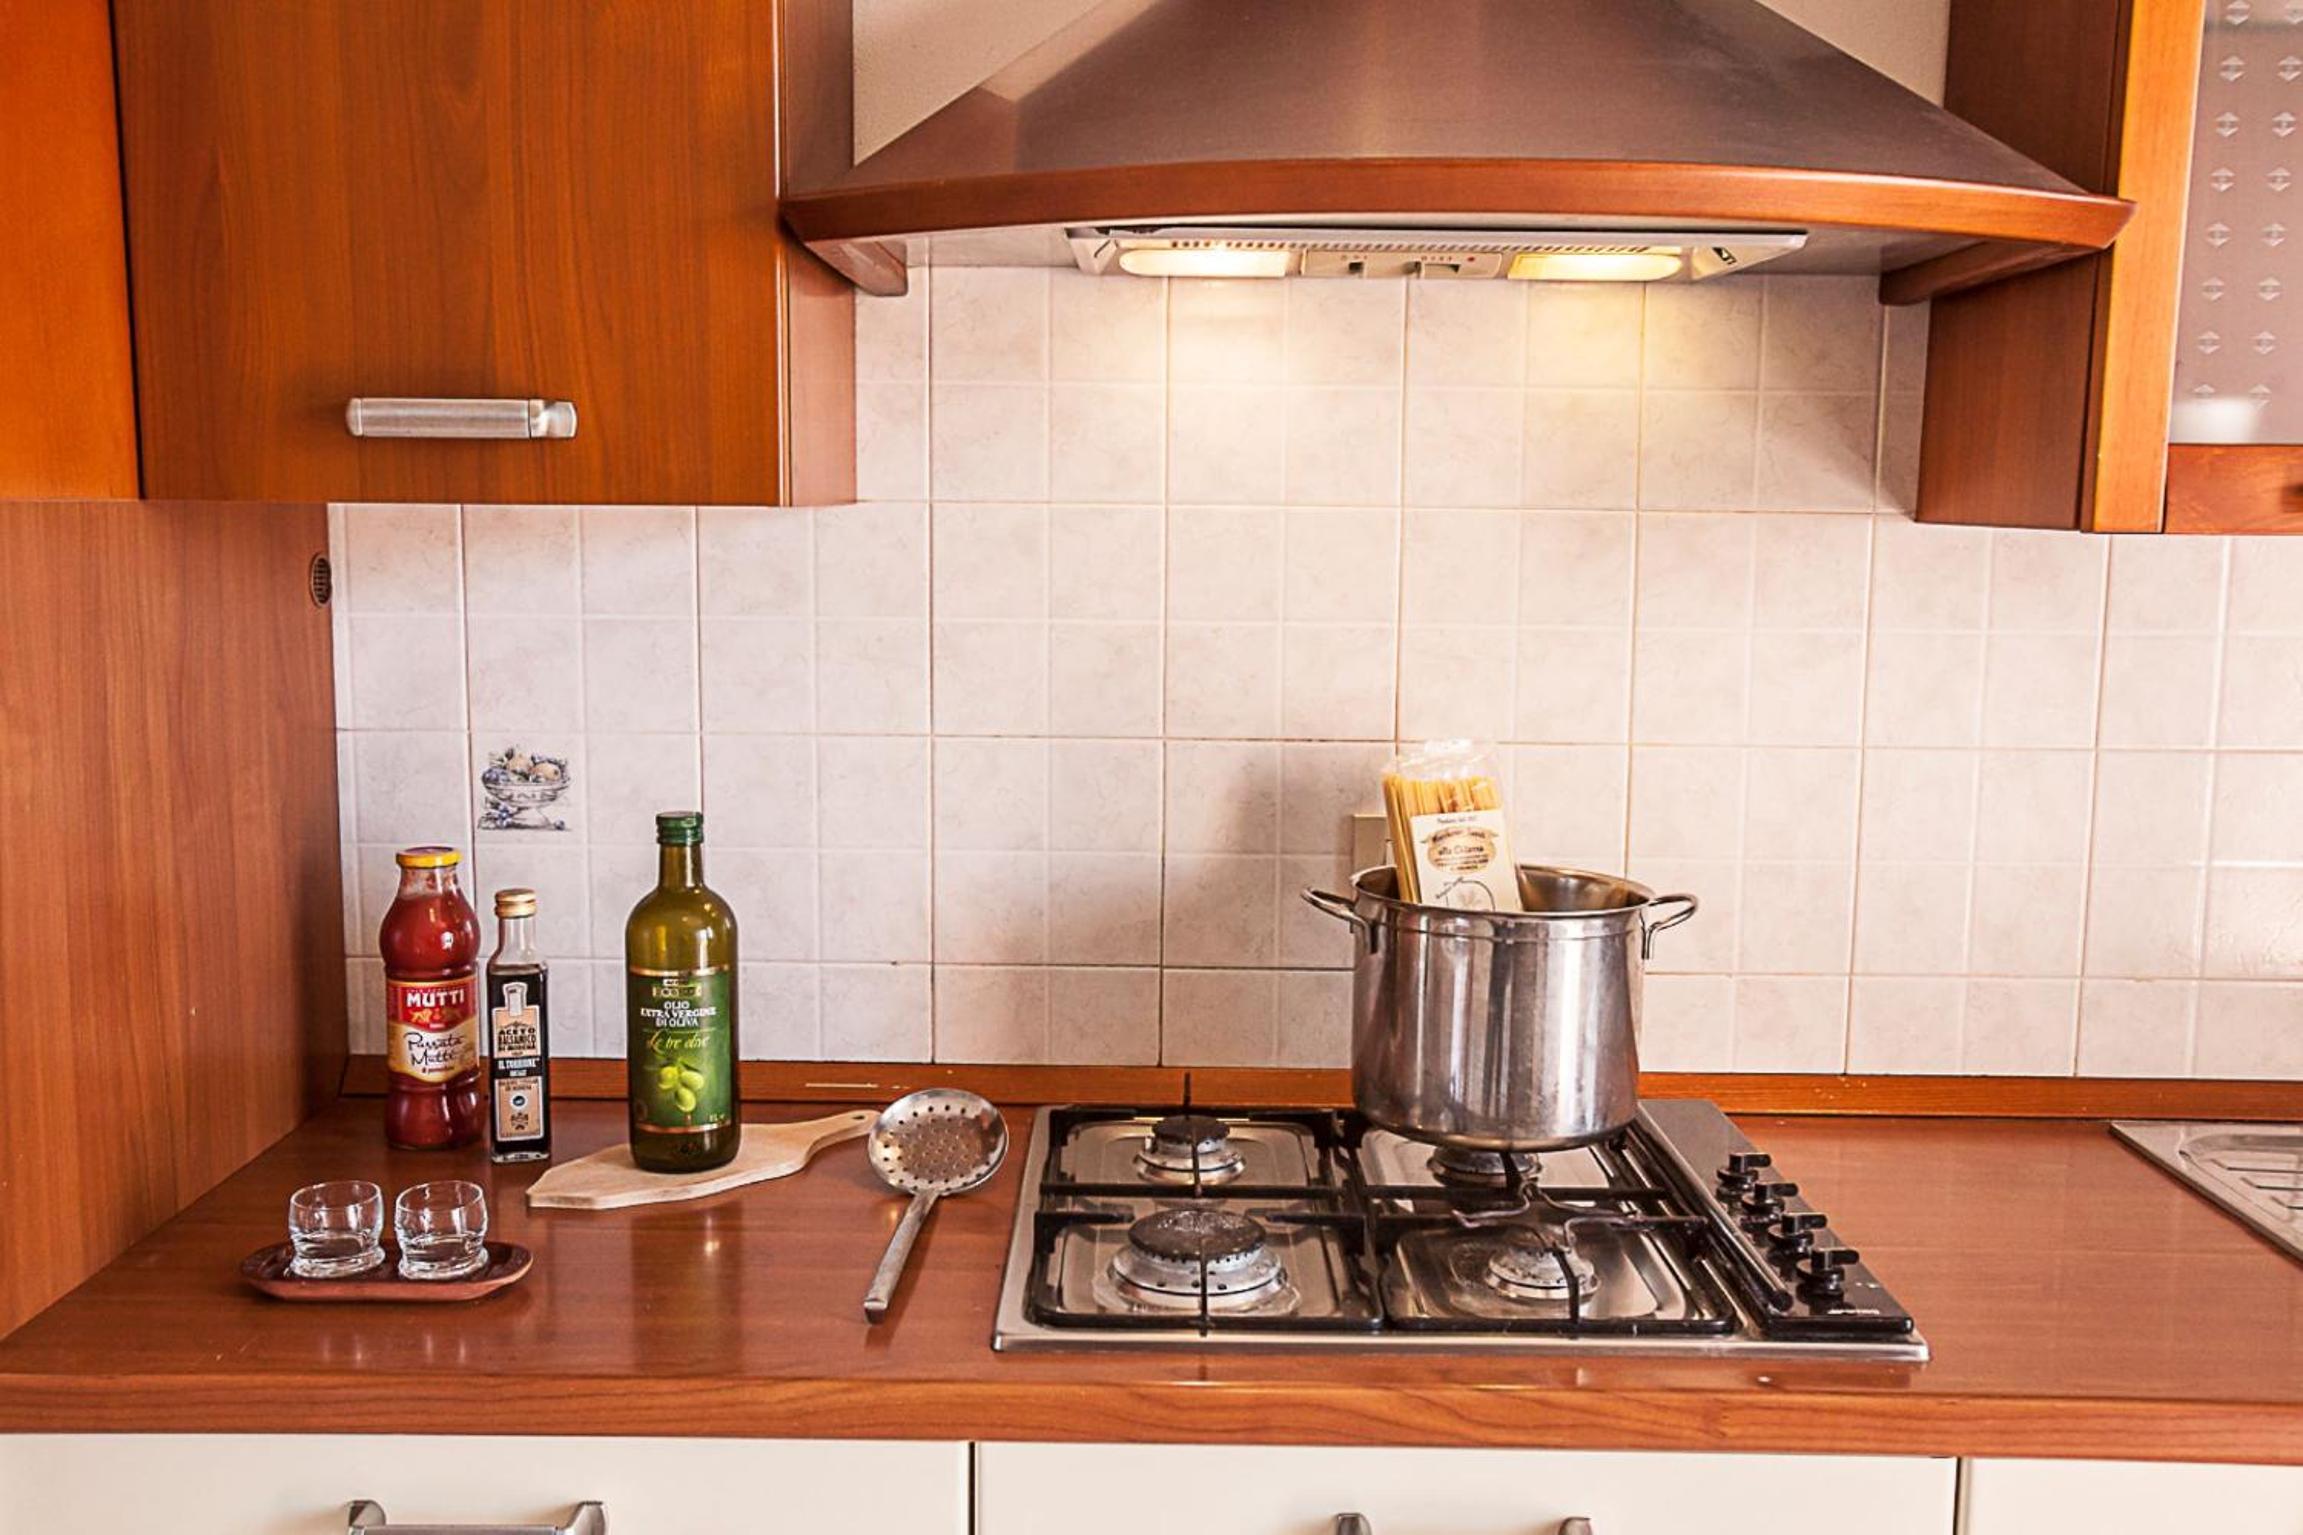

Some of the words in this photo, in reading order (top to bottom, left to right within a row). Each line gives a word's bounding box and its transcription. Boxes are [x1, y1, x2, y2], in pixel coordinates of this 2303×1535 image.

[406, 988, 464, 1007] MUTTI
[664, 1000, 690, 1010] OLIO
[640, 1007, 670, 1018] EXTRA
[671, 1007, 717, 1018] VERGINE
[655, 1017, 667, 1028] DI
[668, 1017, 699, 1028] OLIVA
[498, 1027, 536, 1036] ACETO
[403, 1030, 466, 1051] Passata
[410, 1048, 456, 1066] Mutti
